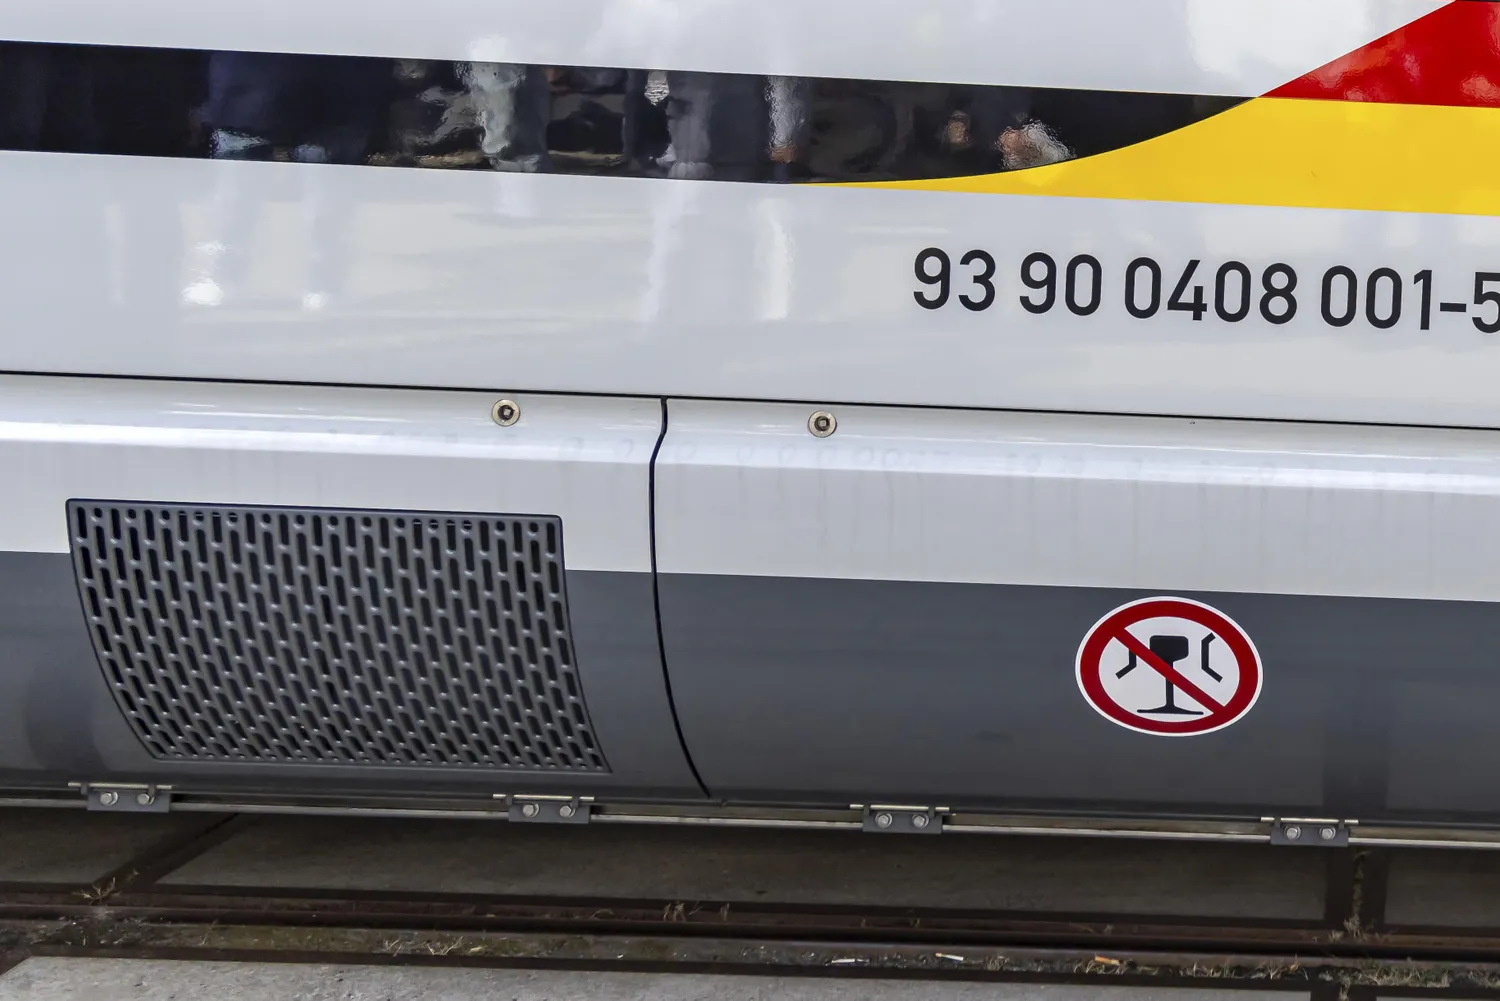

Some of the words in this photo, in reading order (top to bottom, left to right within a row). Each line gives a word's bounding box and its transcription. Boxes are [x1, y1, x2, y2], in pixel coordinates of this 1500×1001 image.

[913, 247, 996, 312] 93
[1019, 251, 1103, 317] 90
[1124, 256, 1298, 325] 0408
